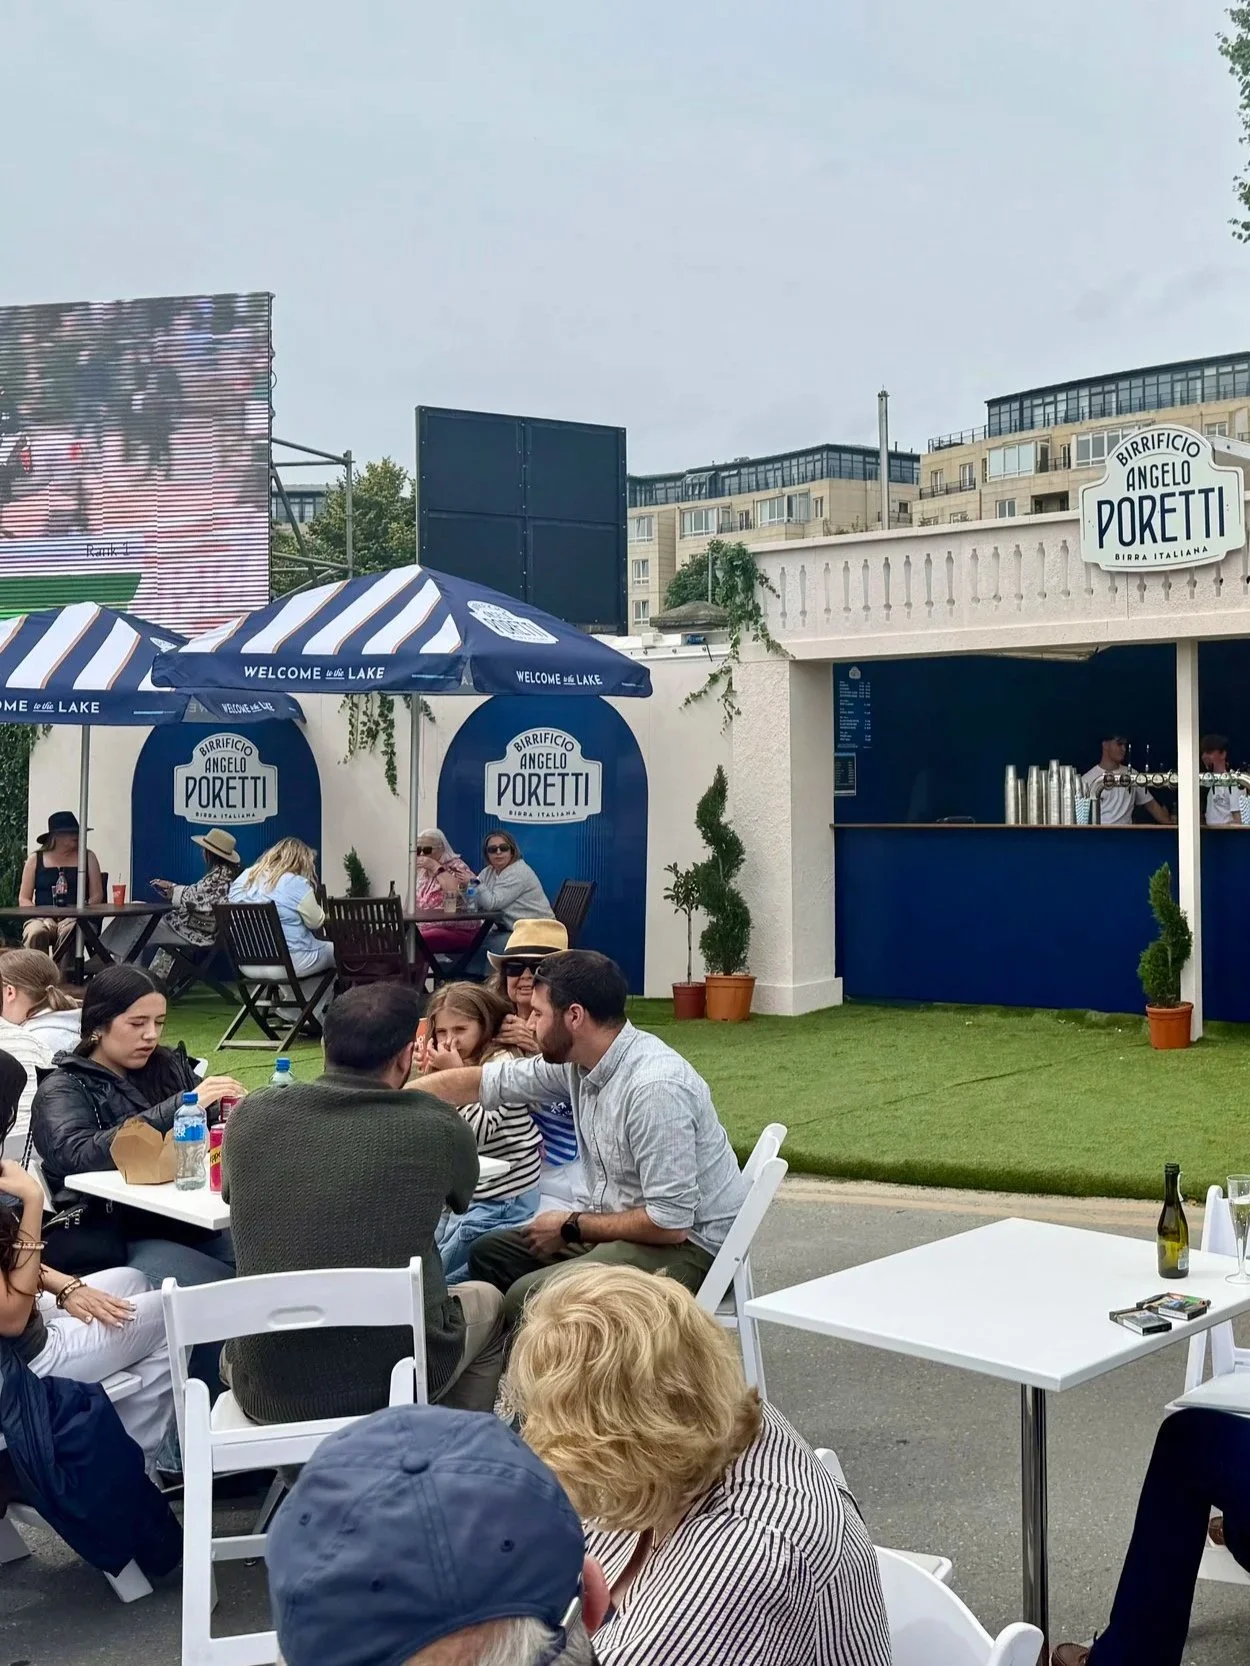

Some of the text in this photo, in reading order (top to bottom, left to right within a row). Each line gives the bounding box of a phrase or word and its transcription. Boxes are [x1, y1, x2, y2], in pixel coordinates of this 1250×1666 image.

[1116, 432, 1201, 467] BIRRIFICIO
[1126, 460, 1191, 492] ANGELO
[1096, 486, 1225, 549] PORETTI
[86, 542, 118, 557] Rank
[1115, 546, 1208, 561] BIRRA ITALIANA
[244, 666, 321, 679] WELCOME
[348, 667, 385, 679] LAKE
[516, 670, 561, 685] WELCOME
[576, 674, 603, 685] LAKE
[58, 702, 100, 713] LAKE
[199, 738, 253, 757] BIRRIFICIO
[514, 732, 575, 752] BIRRIFICIO
[205, 757, 247, 773] ANGELO
[520, 752, 567, 770] ANGELO
[185, 776, 267, 808] PORETTI
[497, 772, 589, 806] PORETTI
